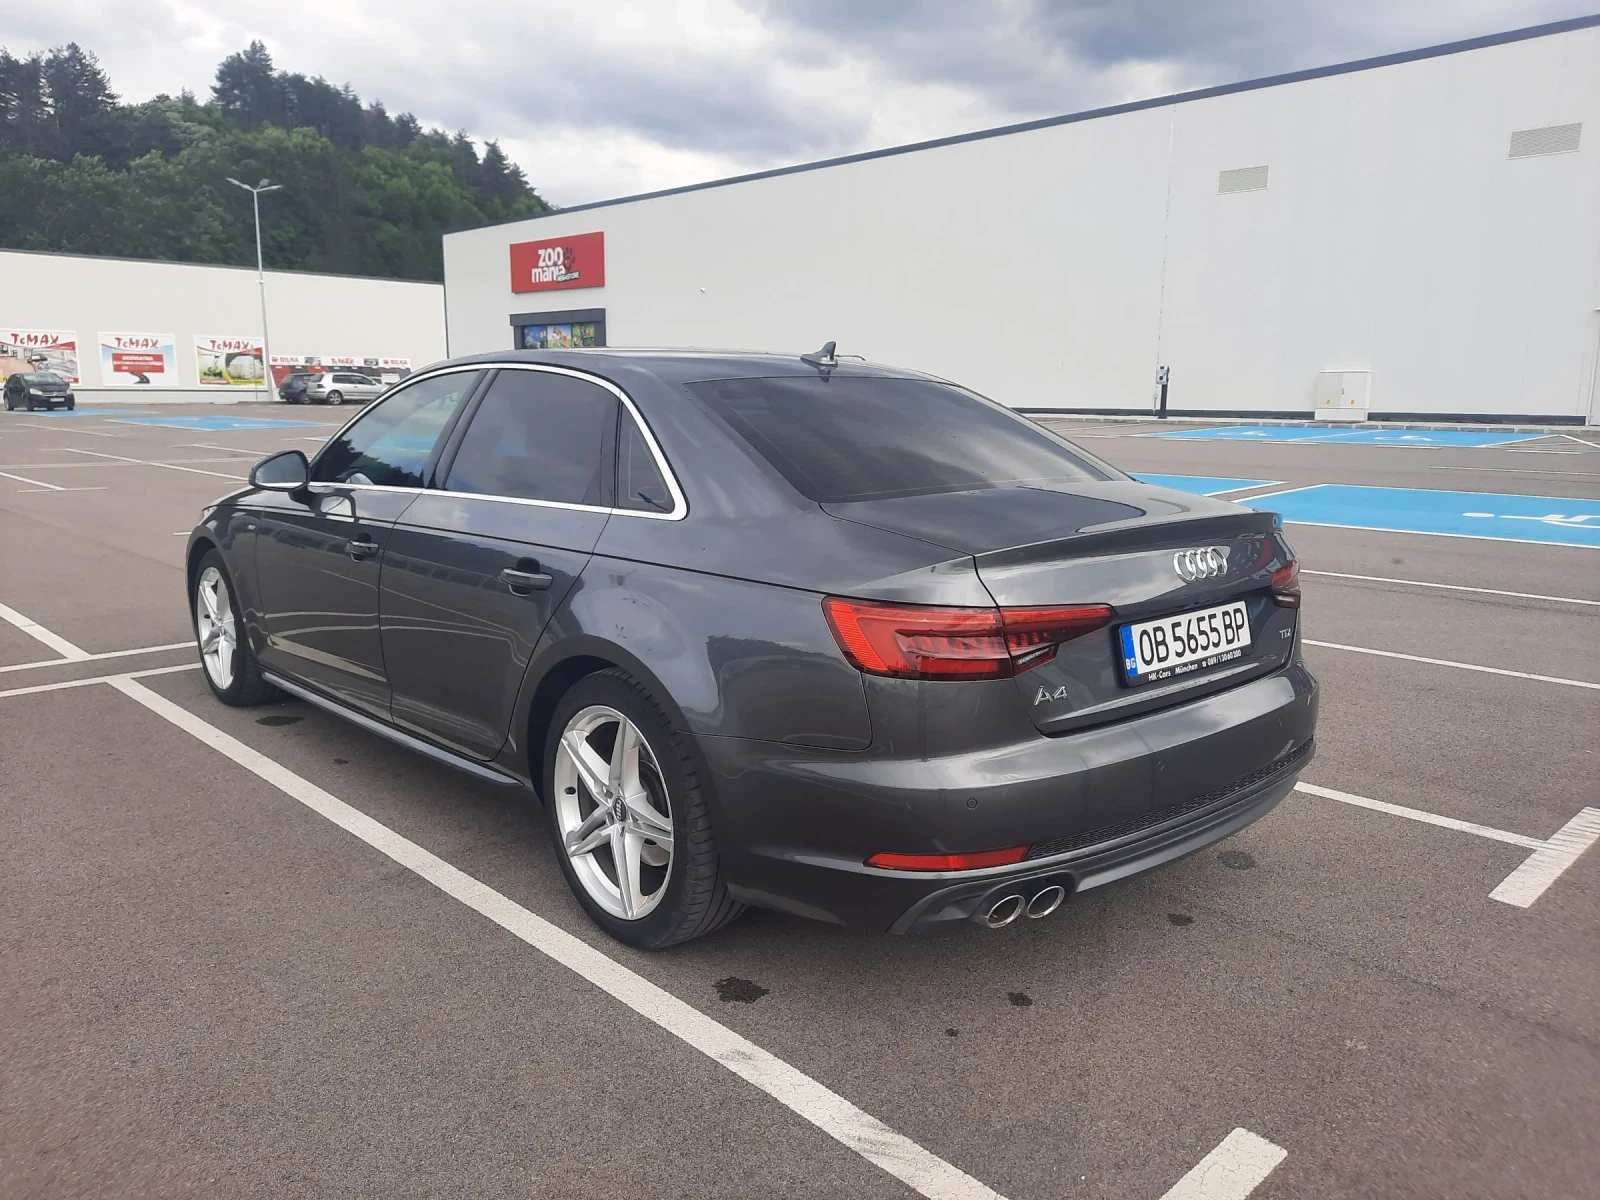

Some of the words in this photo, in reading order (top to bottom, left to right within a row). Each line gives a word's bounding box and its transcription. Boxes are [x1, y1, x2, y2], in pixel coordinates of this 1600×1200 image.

[531, 265, 566, 283] mania
[1139, 626, 1170, 666] OB
[1171, 613, 1222, 658] 5655
[1222, 607, 1245, 646] BP
[1126, 657, 1137, 671] BG
[1148, 669, 1171, 682] HK-Cars
[1175, 663, 1198, 675] München
[1034, 686, 1067, 706] A4
